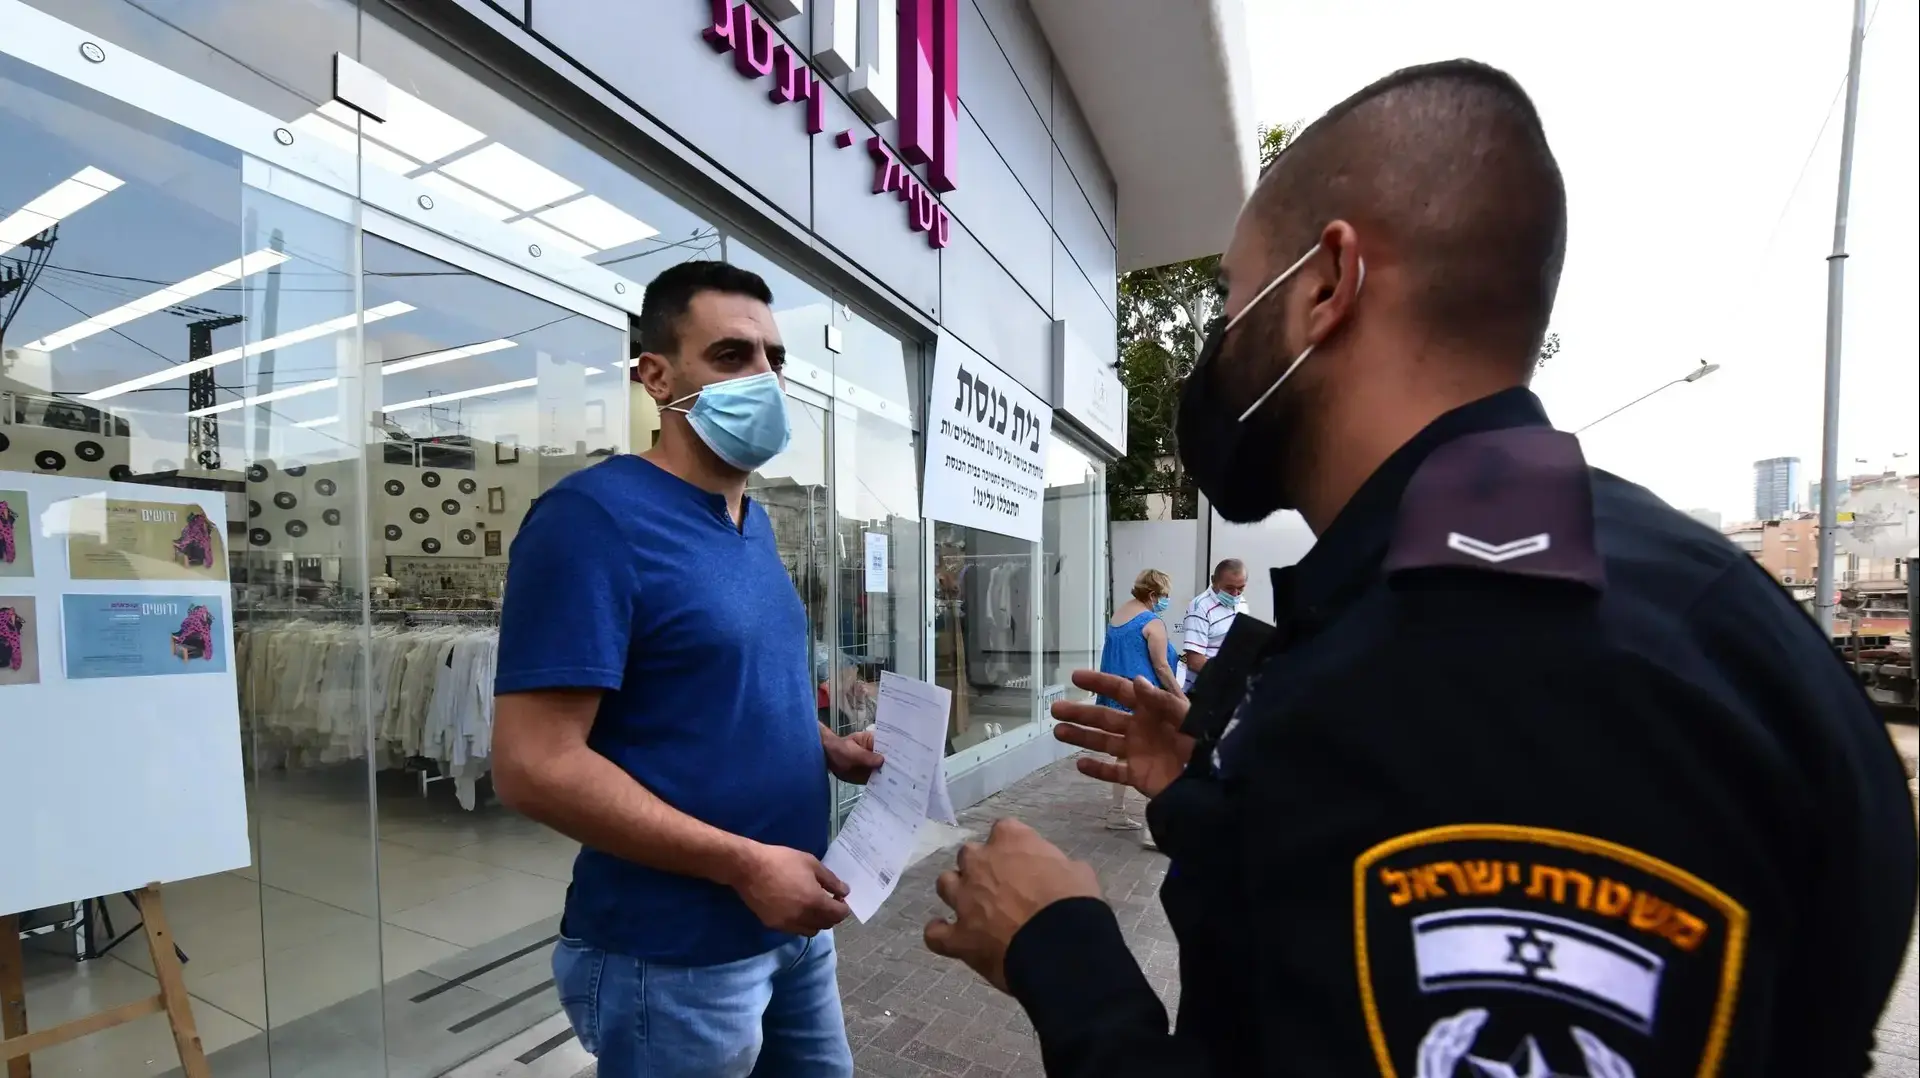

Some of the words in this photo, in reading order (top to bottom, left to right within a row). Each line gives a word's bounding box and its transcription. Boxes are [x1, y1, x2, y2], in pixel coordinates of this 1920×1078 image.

[868, 135, 951, 249] סטייל
[954, 362, 1008, 435] כנסת
[940, 418, 985, 452] מתפללים/ות
[1011, 401, 1040, 453] בית
[986, 440, 994, 456] 10
[995, 445, 1003, 460] עד
[1004, 447, 1012, 464] של
[945, 454, 966, 473] הכנסת
[967, 463, 980, 478] בבית
[1013, 454, 1027, 472] כניסה
[972, 486, 995, 510] עלינו!
[142, 509, 177, 522] דרושים
[142, 603, 178, 615] דרושים
[1379, 859, 1520, 907] ישראל
[1525, 864, 1708, 950] משטרת
